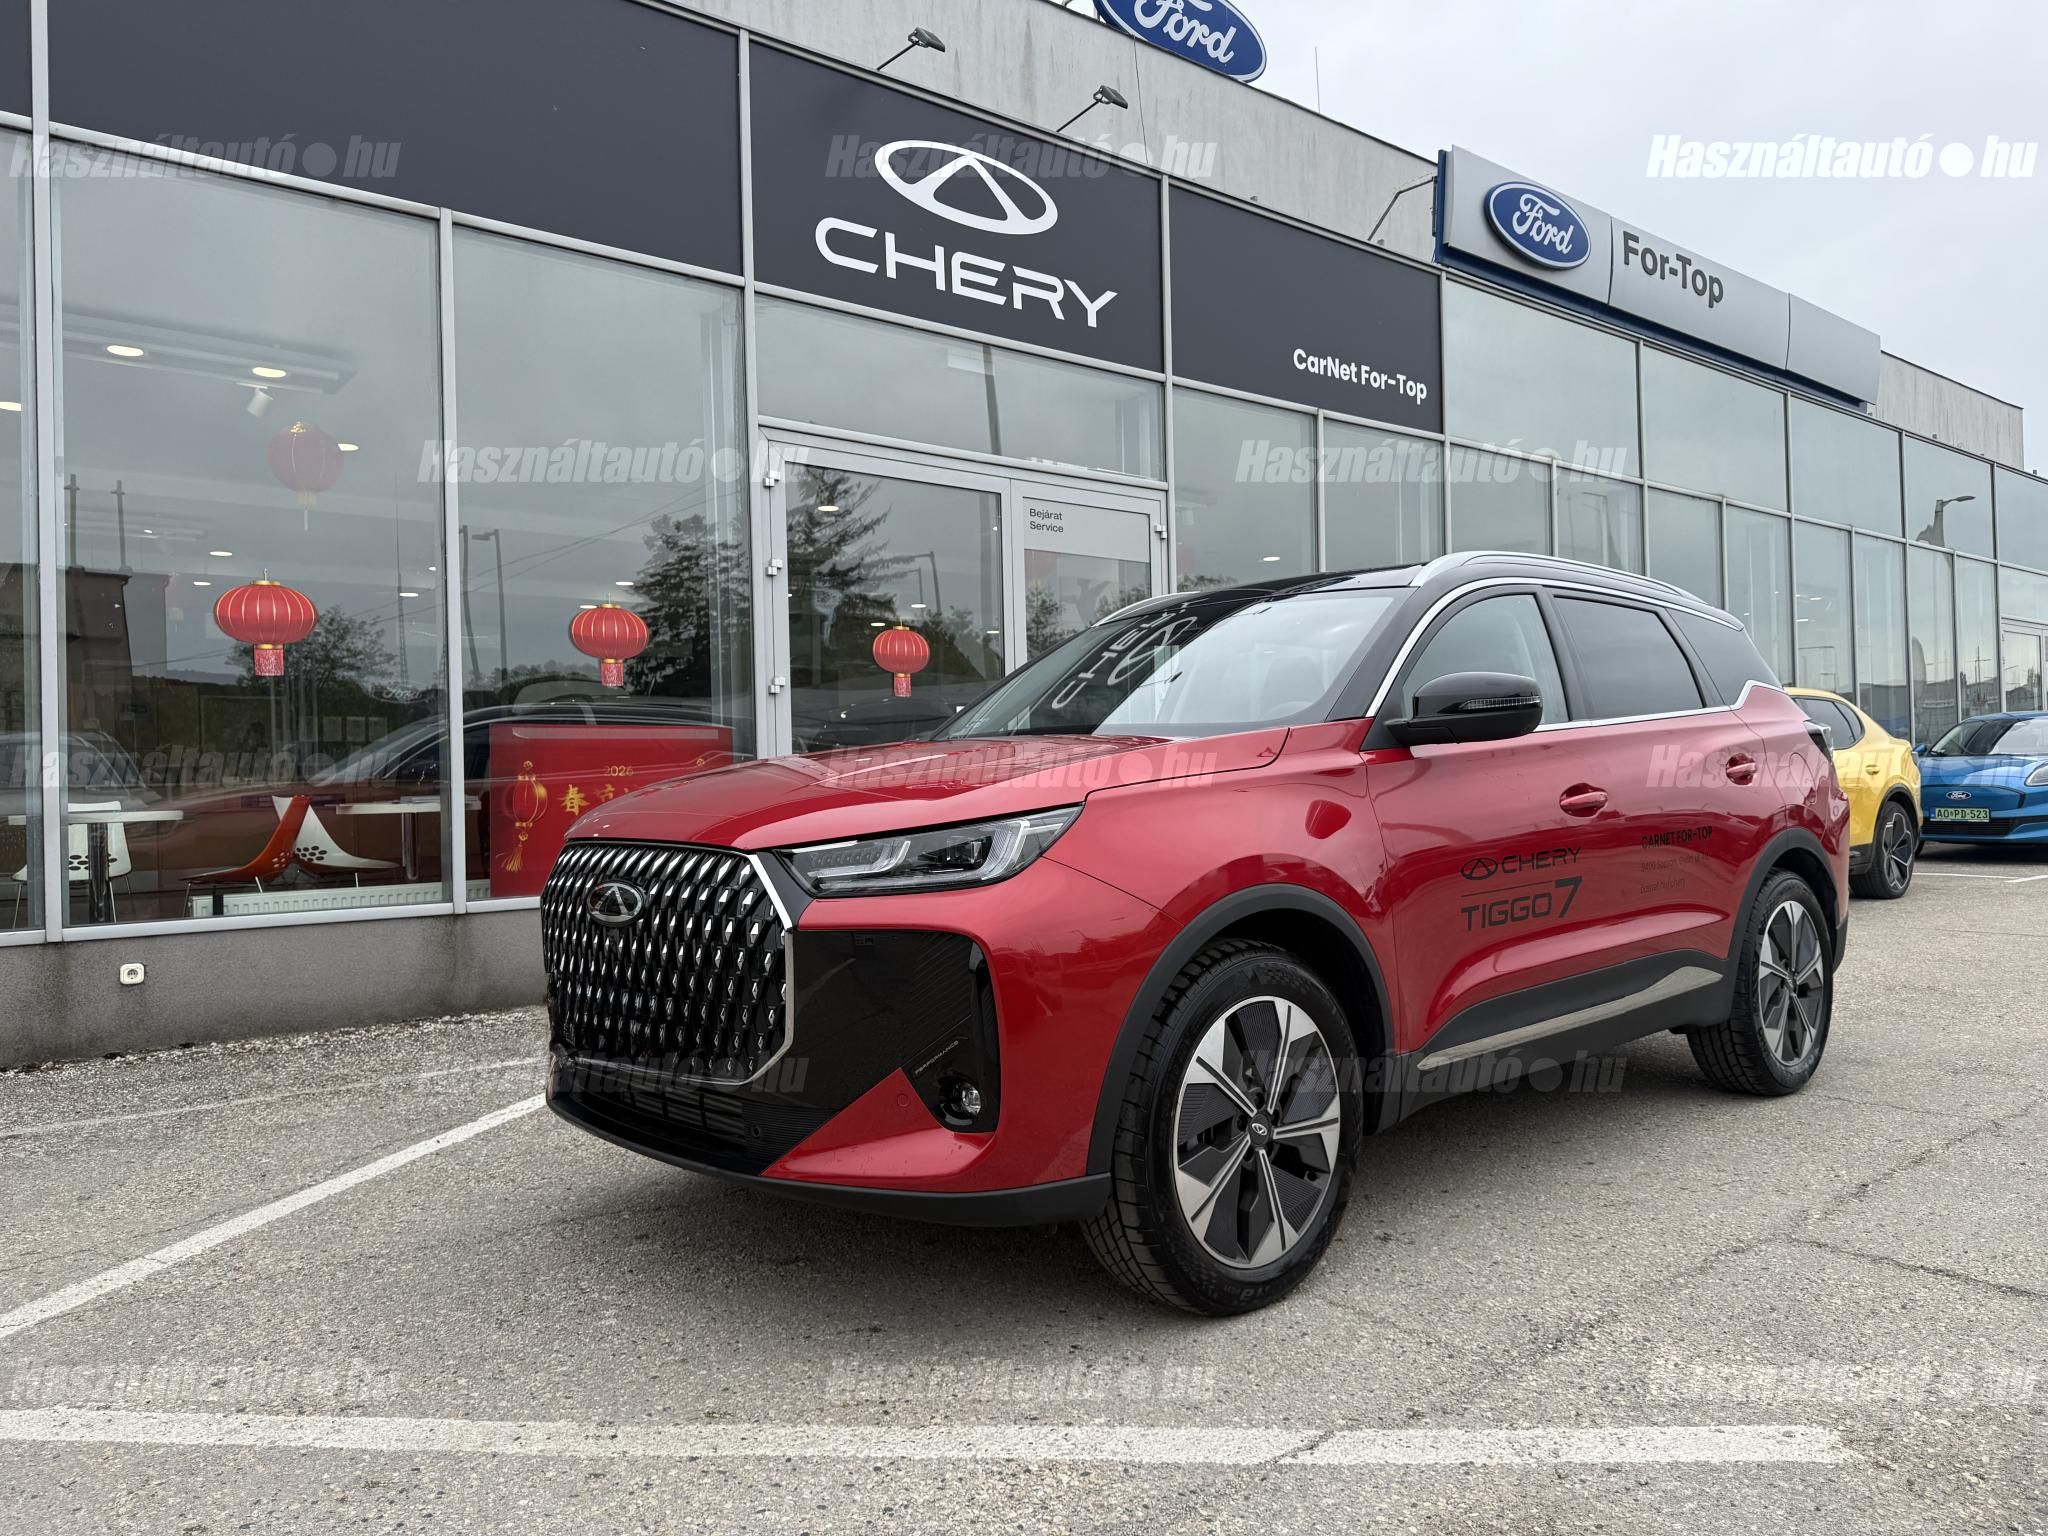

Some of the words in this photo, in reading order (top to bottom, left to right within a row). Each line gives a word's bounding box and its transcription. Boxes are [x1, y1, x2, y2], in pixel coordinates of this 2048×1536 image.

[1511, 193, 1574, 254] Ford
[815, 217, 1118, 329] CHERY
[1623, 231, 1724, 308] For-Top
[1293, 348, 1358, 383] CarNet
[1361, 364, 1427, 405] For-Top
[1029, 508, 1063, 521] Bejárat
[1029, 521, 1064, 533] Service
[605, 766, 634, 777] 2026
[1641, 831, 1675, 848] CARNET
[1677, 826, 1713, 843] FOR-TOP
[1502, 847, 1582, 873] CHERY
[1461, 893, 1552, 931] TIGGO
[1555, 876, 1582, 918] 7
